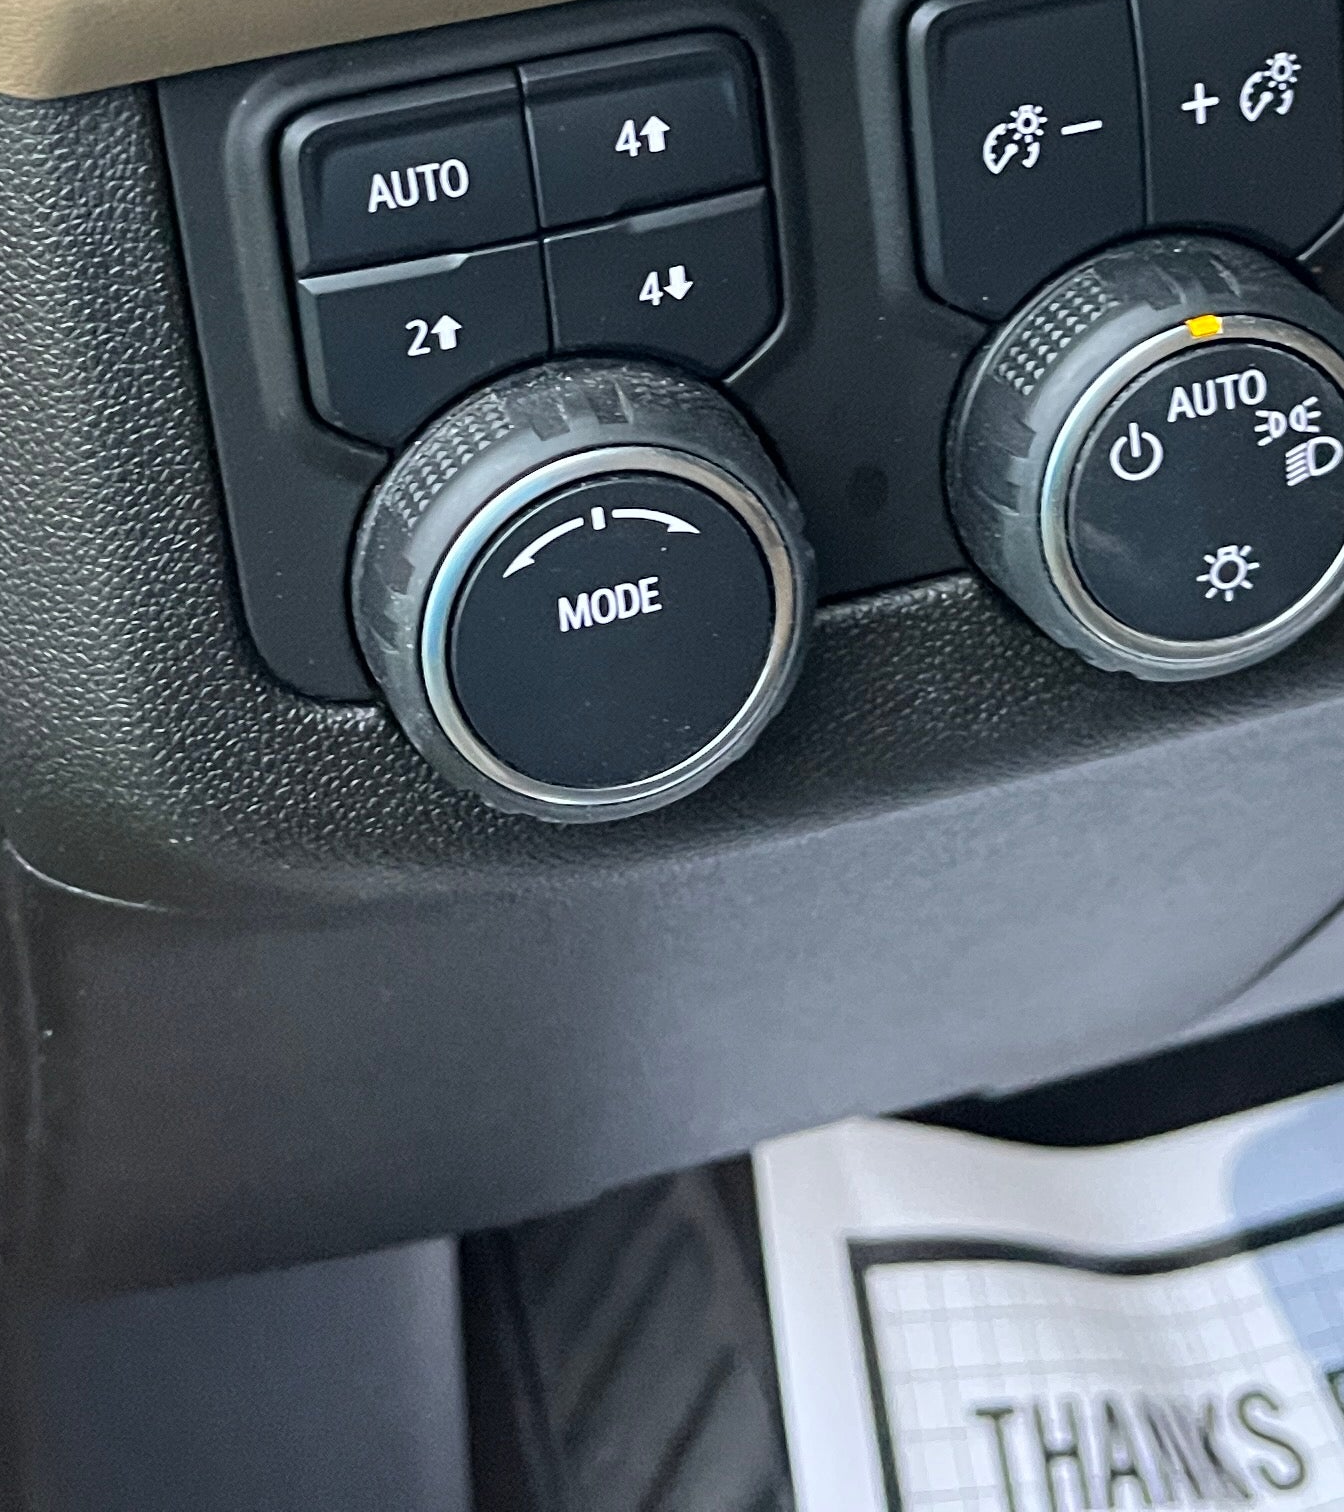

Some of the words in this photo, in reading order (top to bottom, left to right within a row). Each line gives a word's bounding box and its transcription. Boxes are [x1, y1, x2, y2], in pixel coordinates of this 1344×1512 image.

[615, 119, 641, 157] 4
[367, 158, 469, 213] AUTO
[638, 271, 664, 306] 4
[405, 319, 431, 357] 2
[1166, 368, 1268, 423] AUTO
[557, 576, 663, 633] MODE
[974, 1390, 1306, 1512] THANKS
